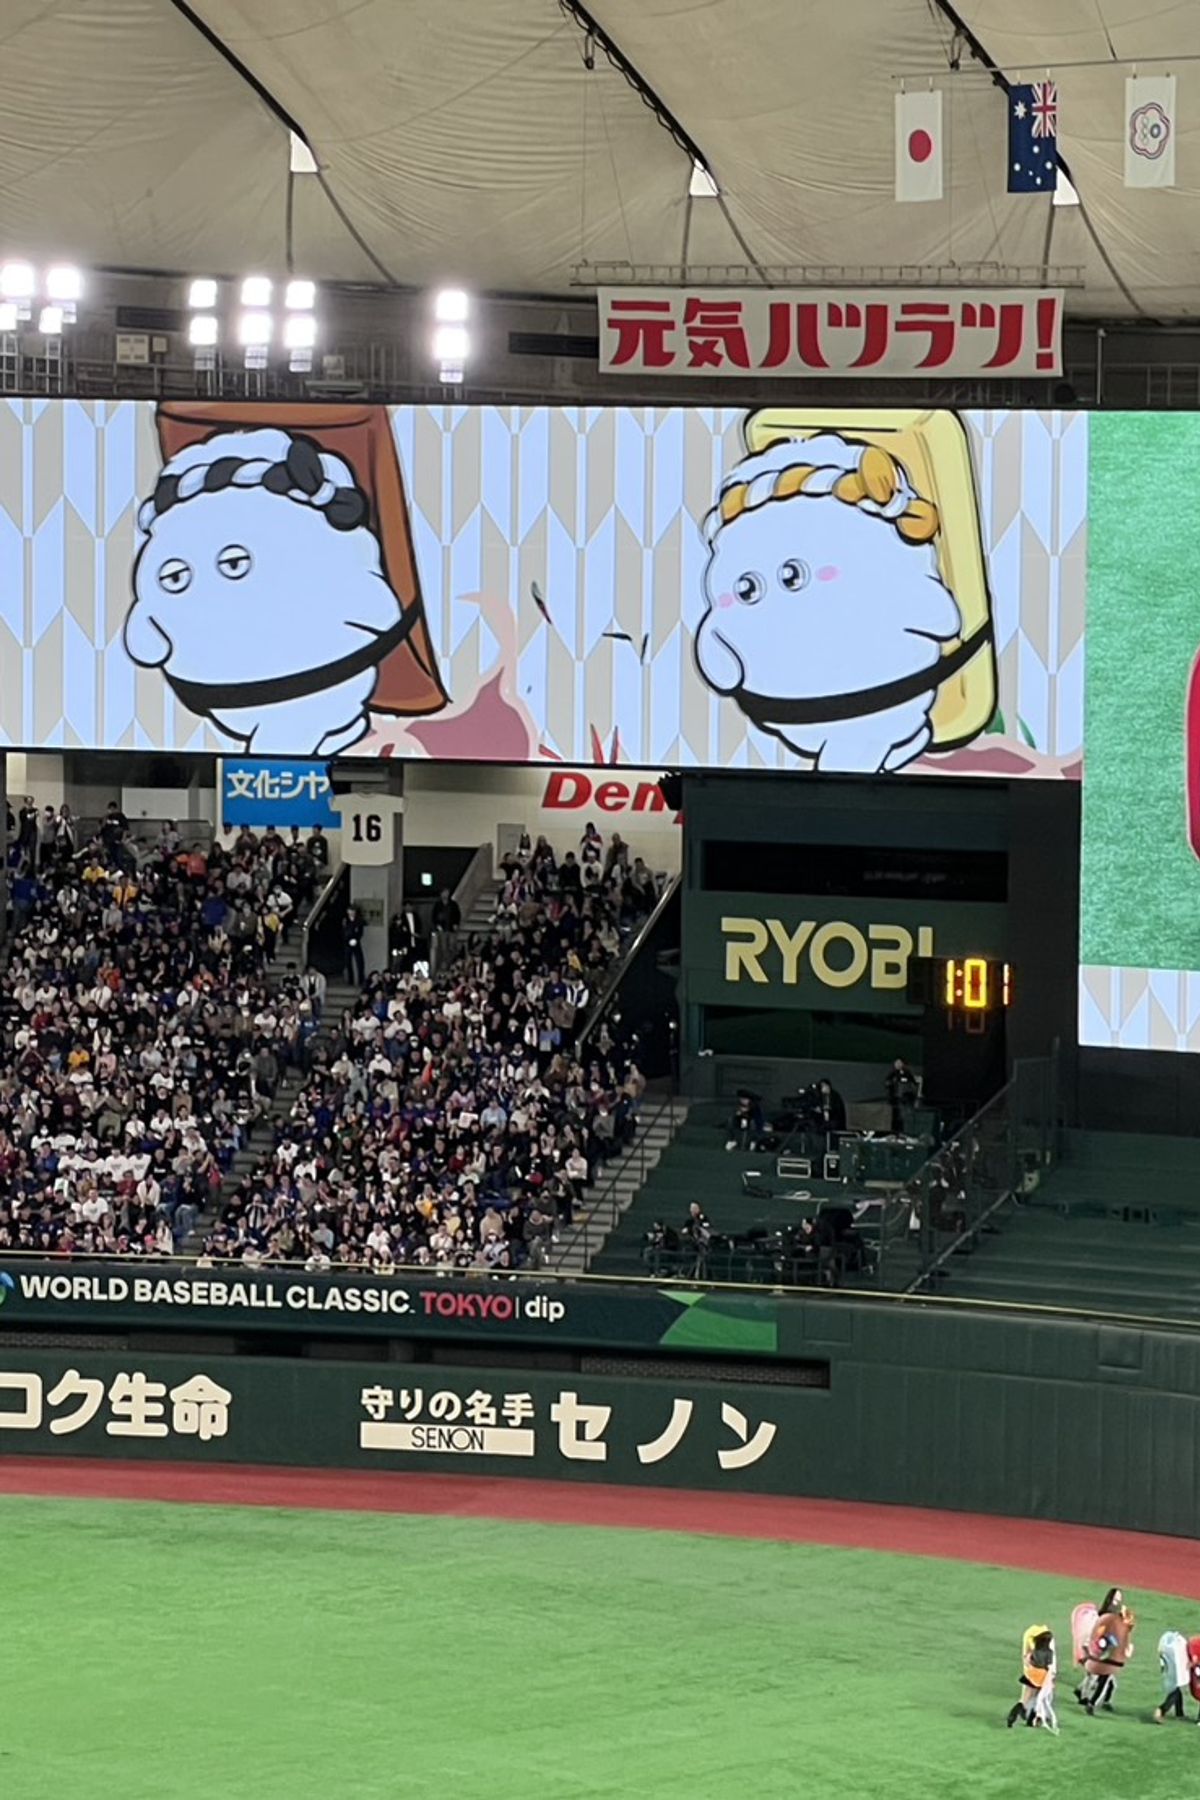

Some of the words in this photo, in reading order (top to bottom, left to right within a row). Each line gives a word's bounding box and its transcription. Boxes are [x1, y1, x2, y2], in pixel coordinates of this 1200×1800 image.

[606, 298, 1057, 370] 元気ハツラツ!
[542, 771, 685, 824] Den
[352, 814, 382, 842] 16
[20, 1275, 128, 1301] WORLD
[134, 1279, 282, 1308] BASEBALL
[420, 1292, 513, 1319] TOKYO
[524, 1296, 565, 1322] dip
[361, 1386, 535, 1427] 守りの名手
[411, 1426, 484, 1451] SENON
